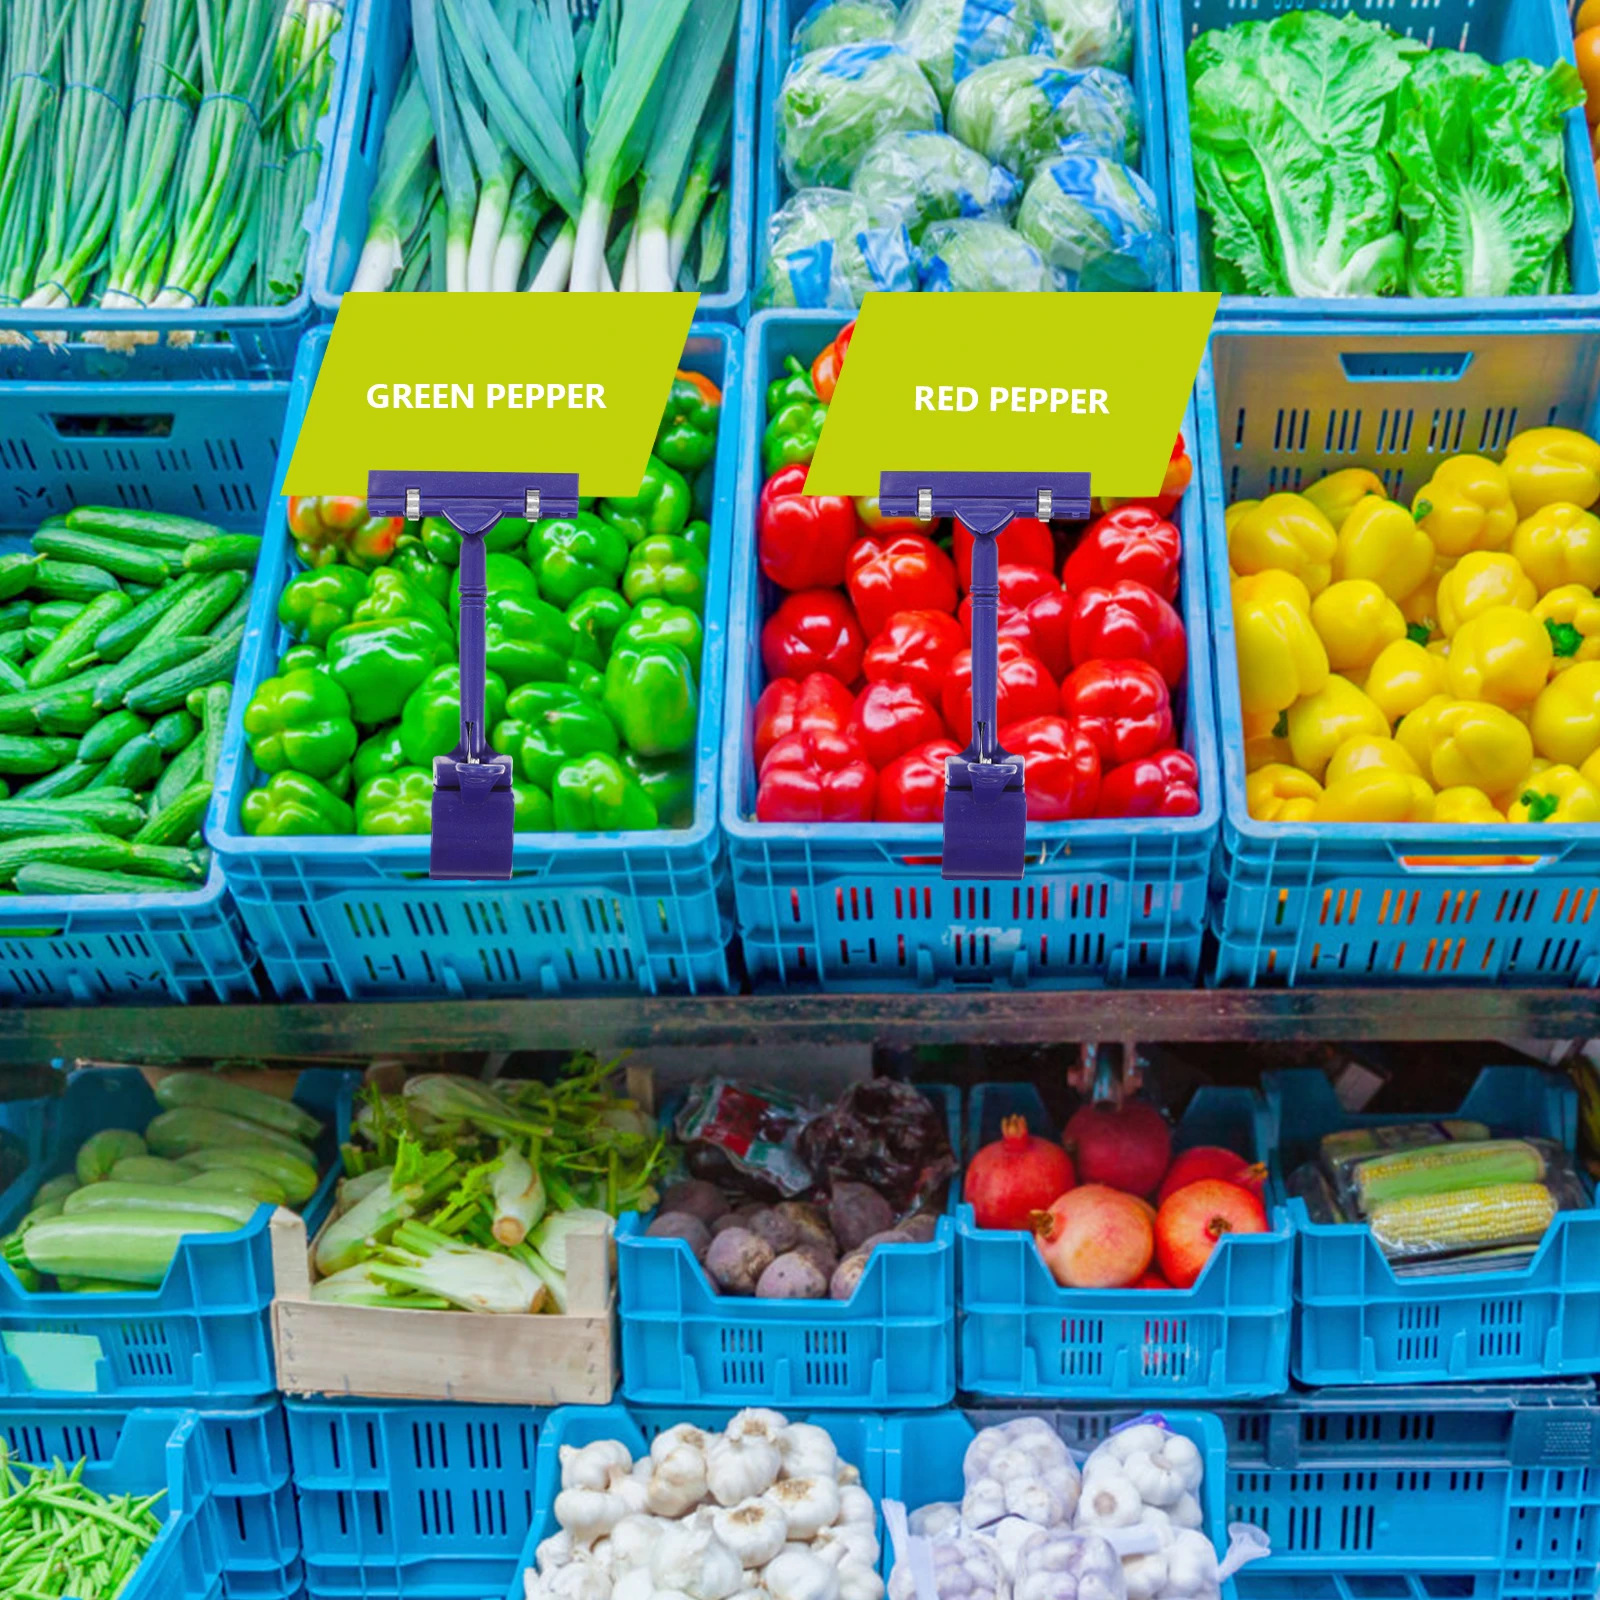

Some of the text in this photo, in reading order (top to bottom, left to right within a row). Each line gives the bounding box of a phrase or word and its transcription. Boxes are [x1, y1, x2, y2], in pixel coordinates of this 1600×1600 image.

[366, 383, 607, 409] GREEN PEPPER
[915, 385, 1110, 415] RED PEPPER
